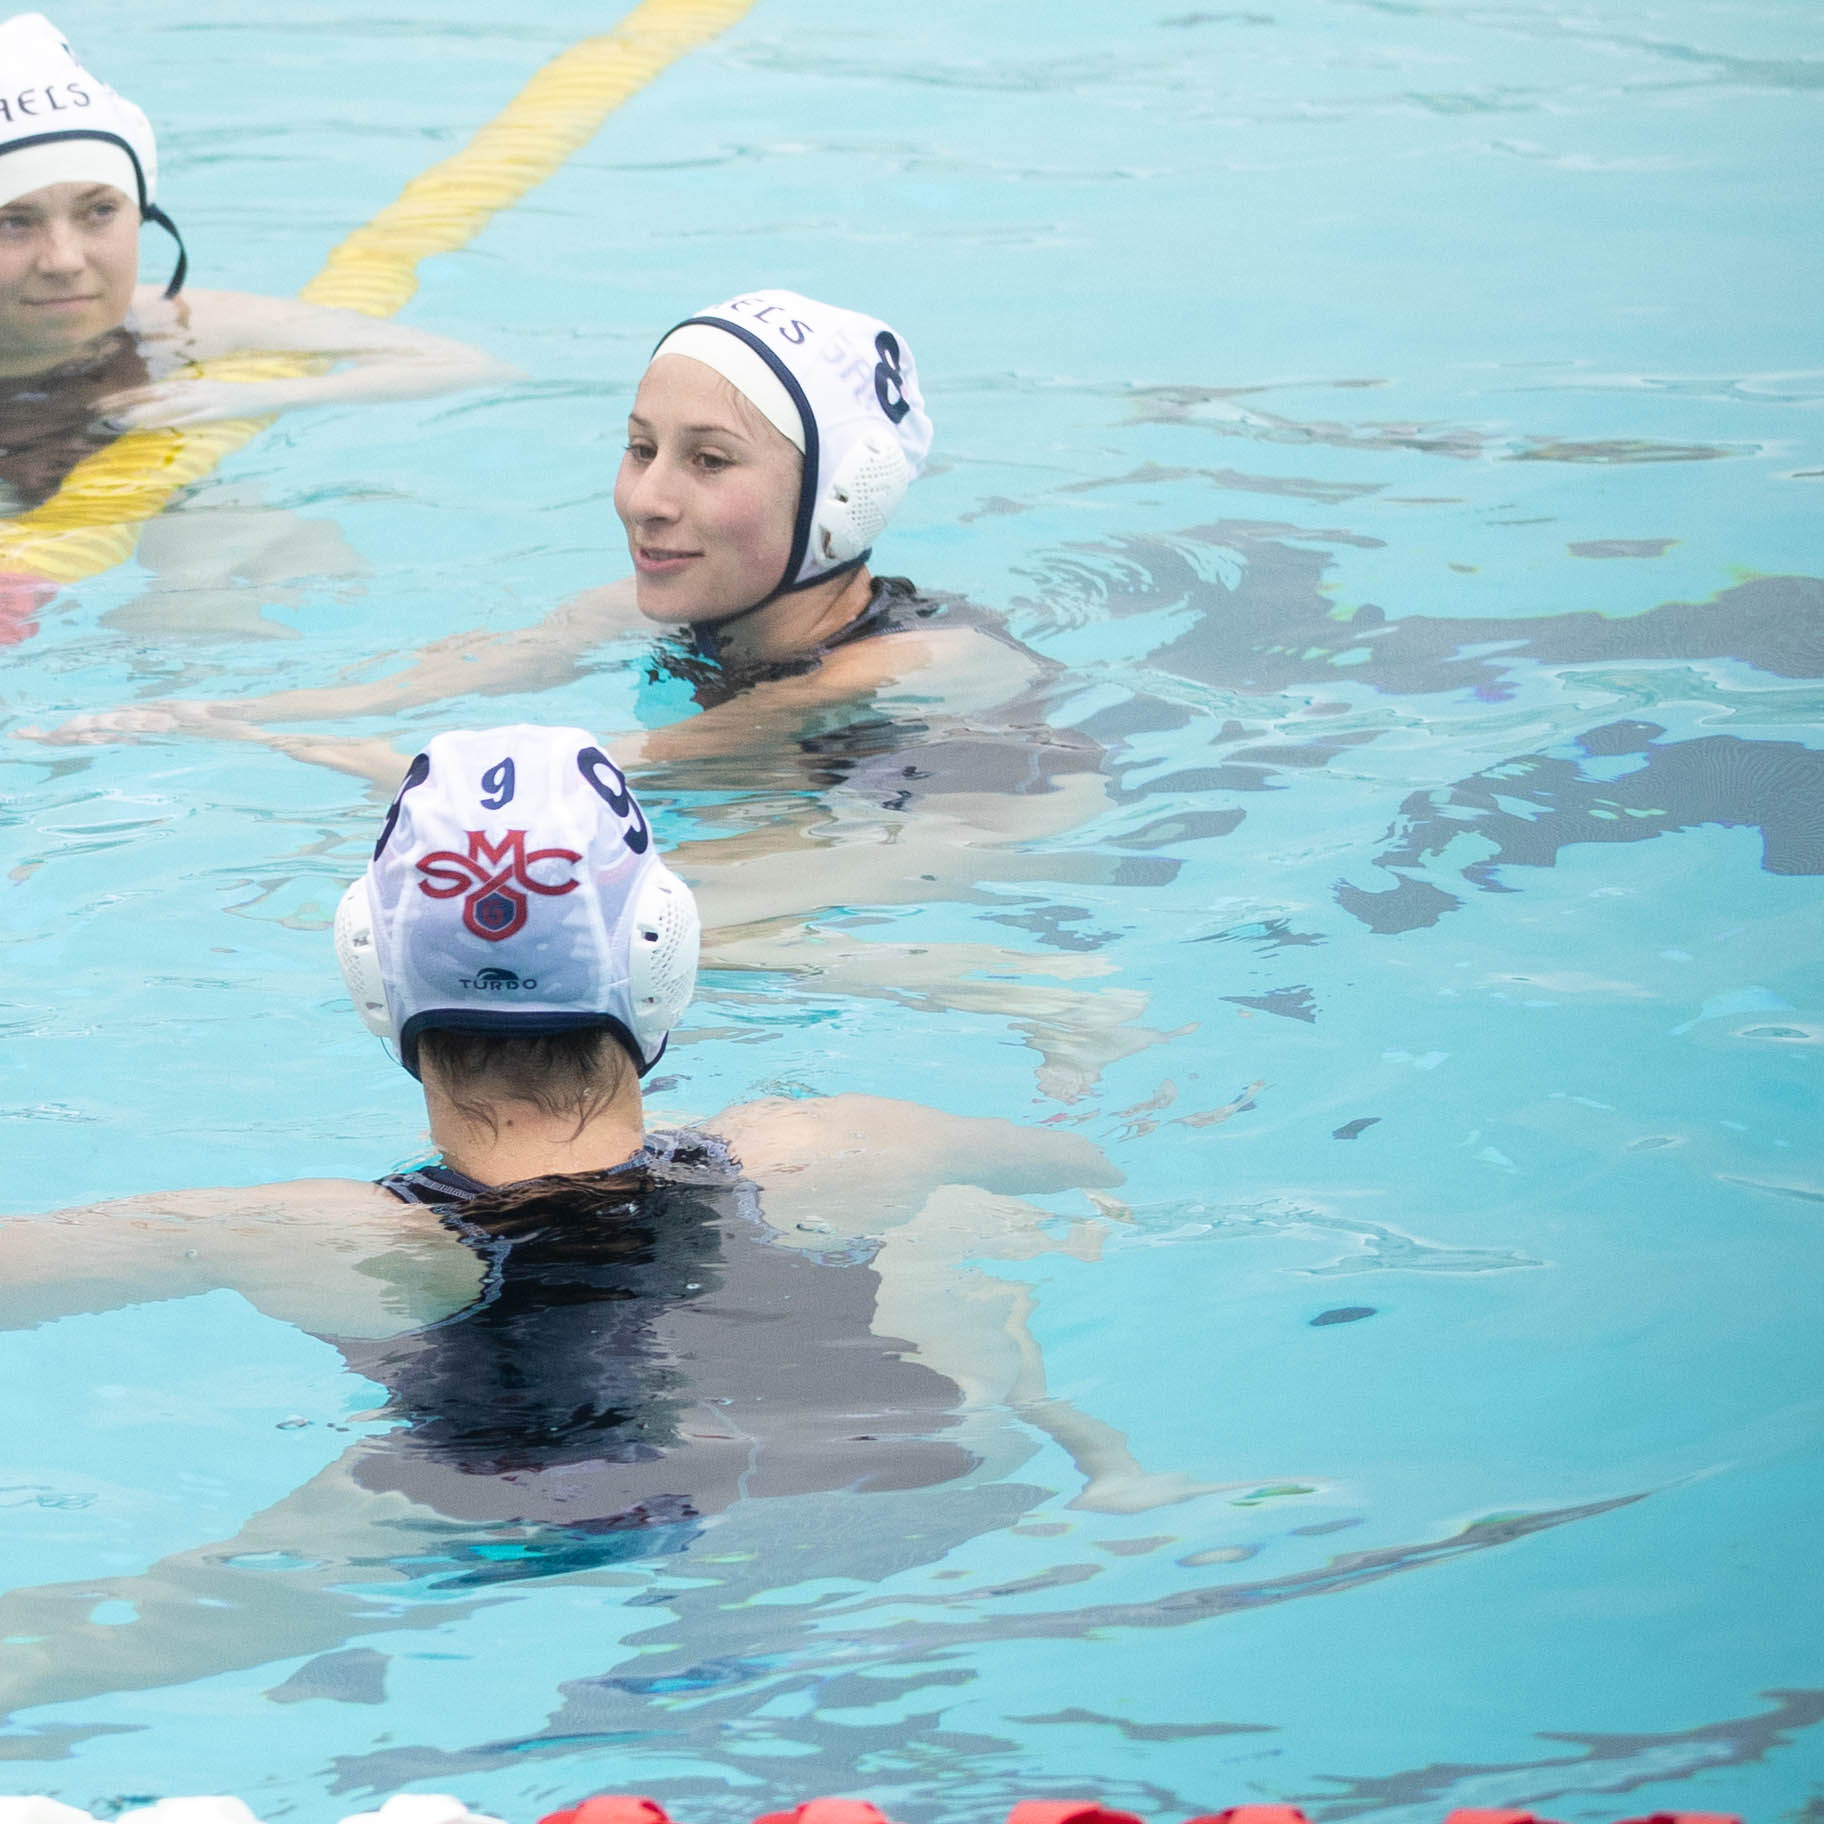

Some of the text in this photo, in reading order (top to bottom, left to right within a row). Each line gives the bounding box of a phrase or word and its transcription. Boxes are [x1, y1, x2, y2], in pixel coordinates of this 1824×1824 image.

[874, 330, 910, 425] 8
[480, 757, 516, 810] 9
[577, 746, 649, 855] 9
[415, 829, 583, 899] SMC
[459, 979, 538, 992] TURBO
